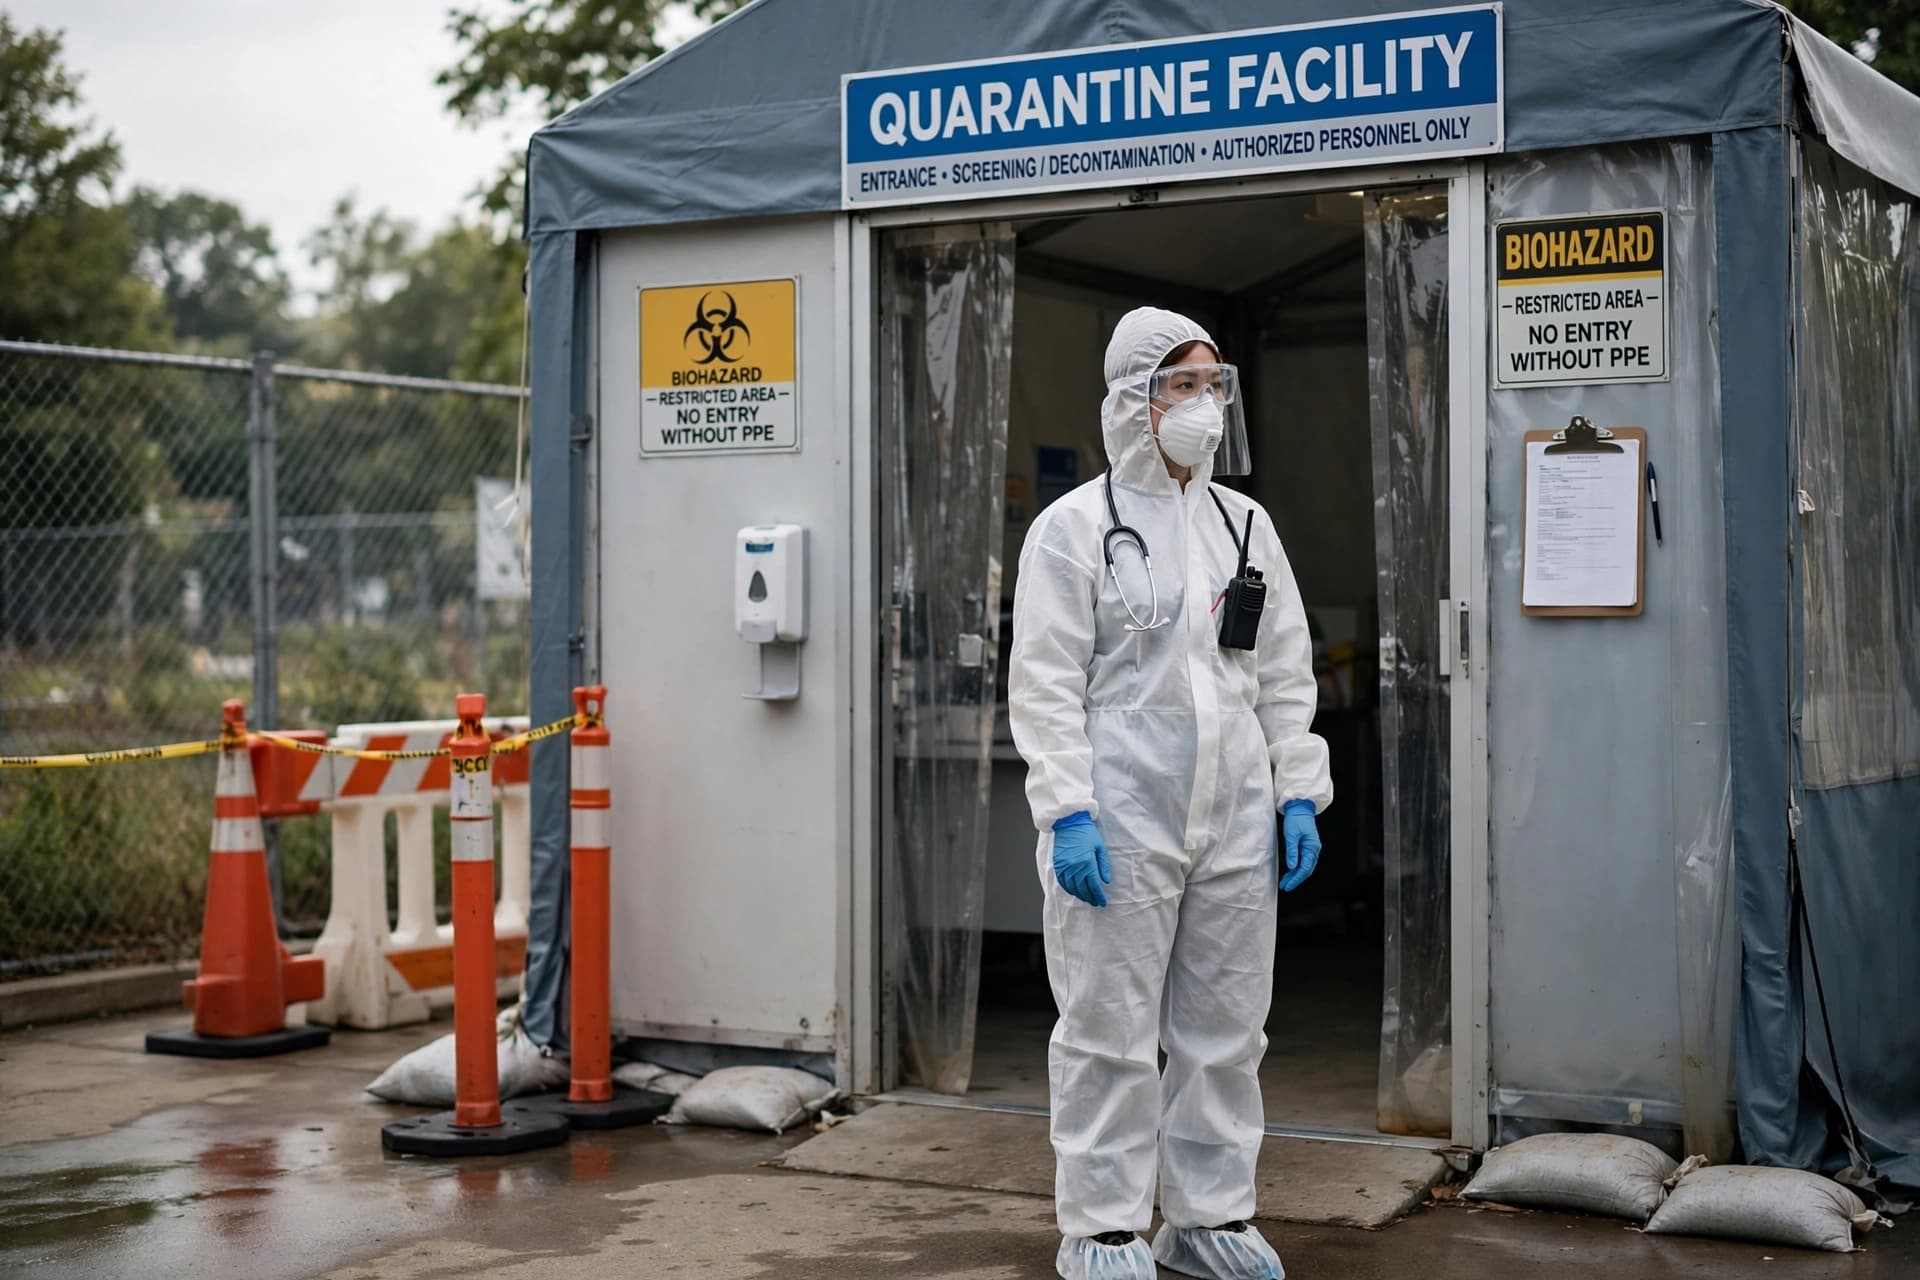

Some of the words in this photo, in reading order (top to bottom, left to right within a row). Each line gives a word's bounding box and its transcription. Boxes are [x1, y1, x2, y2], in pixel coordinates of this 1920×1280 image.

[869, 59, 1211, 146] QUARANTINE
[1229, 31, 1473, 110] FACILITY
[860, 166, 937, 193] ENTRANCE
[952, 156, 1037, 185] SCREENING
[1049, 142, 1195, 176] DECONTAMINATION
[1212, 131, 1314, 161] AUTHORIZED
[1319, 121, 1422, 152] PERSONNEL
[1425, 116, 1471, 142] ONLY
[1505, 225, 1655, 271] BIOHAZARD
[1515, 291, 1601, 315] RESTRICTED
[1604, 289, 1644, 310] AREA
[1529, 324, 1558, 345] NO
[1565, 320, 1633, 343] ENTRY
[1510, 348, 1604, 372] WITHOUT
[1610, 346, 1650, 367] PPE
[672, 367, 762, 386] BIOHAZARD
[659, 389, 737, 406] RESTRICTED
[740, 387, 777, 402] AREA
[677, 408, 700, 425] NO
[706, 406, 760, 424] ENTRY
[661, 427, 737, 445] WITHOUT
[742, 425, 775, 441] PPE
